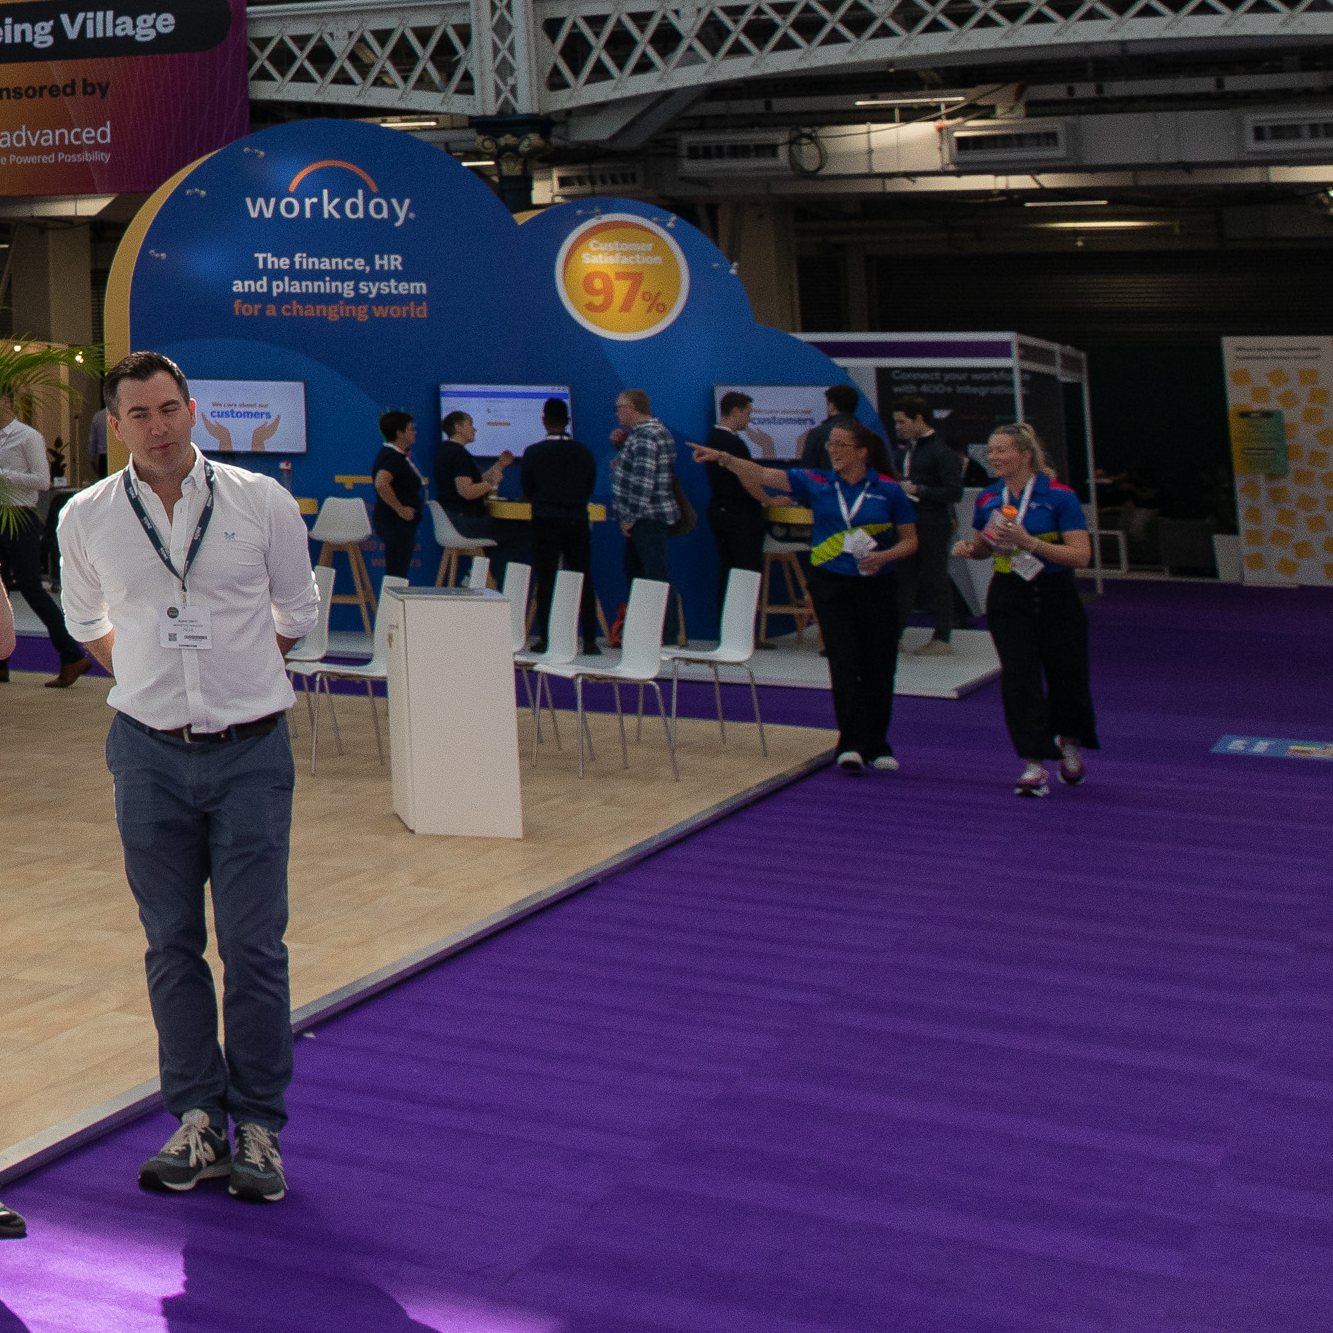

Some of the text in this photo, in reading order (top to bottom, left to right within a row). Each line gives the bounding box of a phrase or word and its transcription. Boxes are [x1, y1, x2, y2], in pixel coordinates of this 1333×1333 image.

[58, 9, 176, 43] Village
[81, 77, 111, 101] by
[9, 152, 56, 166] Powered
[59, 149, 111, 165] Possibility
[588, 239, 654, 252] Customer
[253, 252, 403, 273] The finance, HR
[581, 252, 663, 265] Satisfaction
[232, 276, 428, 298] and planning system
[582, 270, 667, 314] 97%
[233, 298, 428, 322] for a changing world
[210, 408, 272, 419] customers
